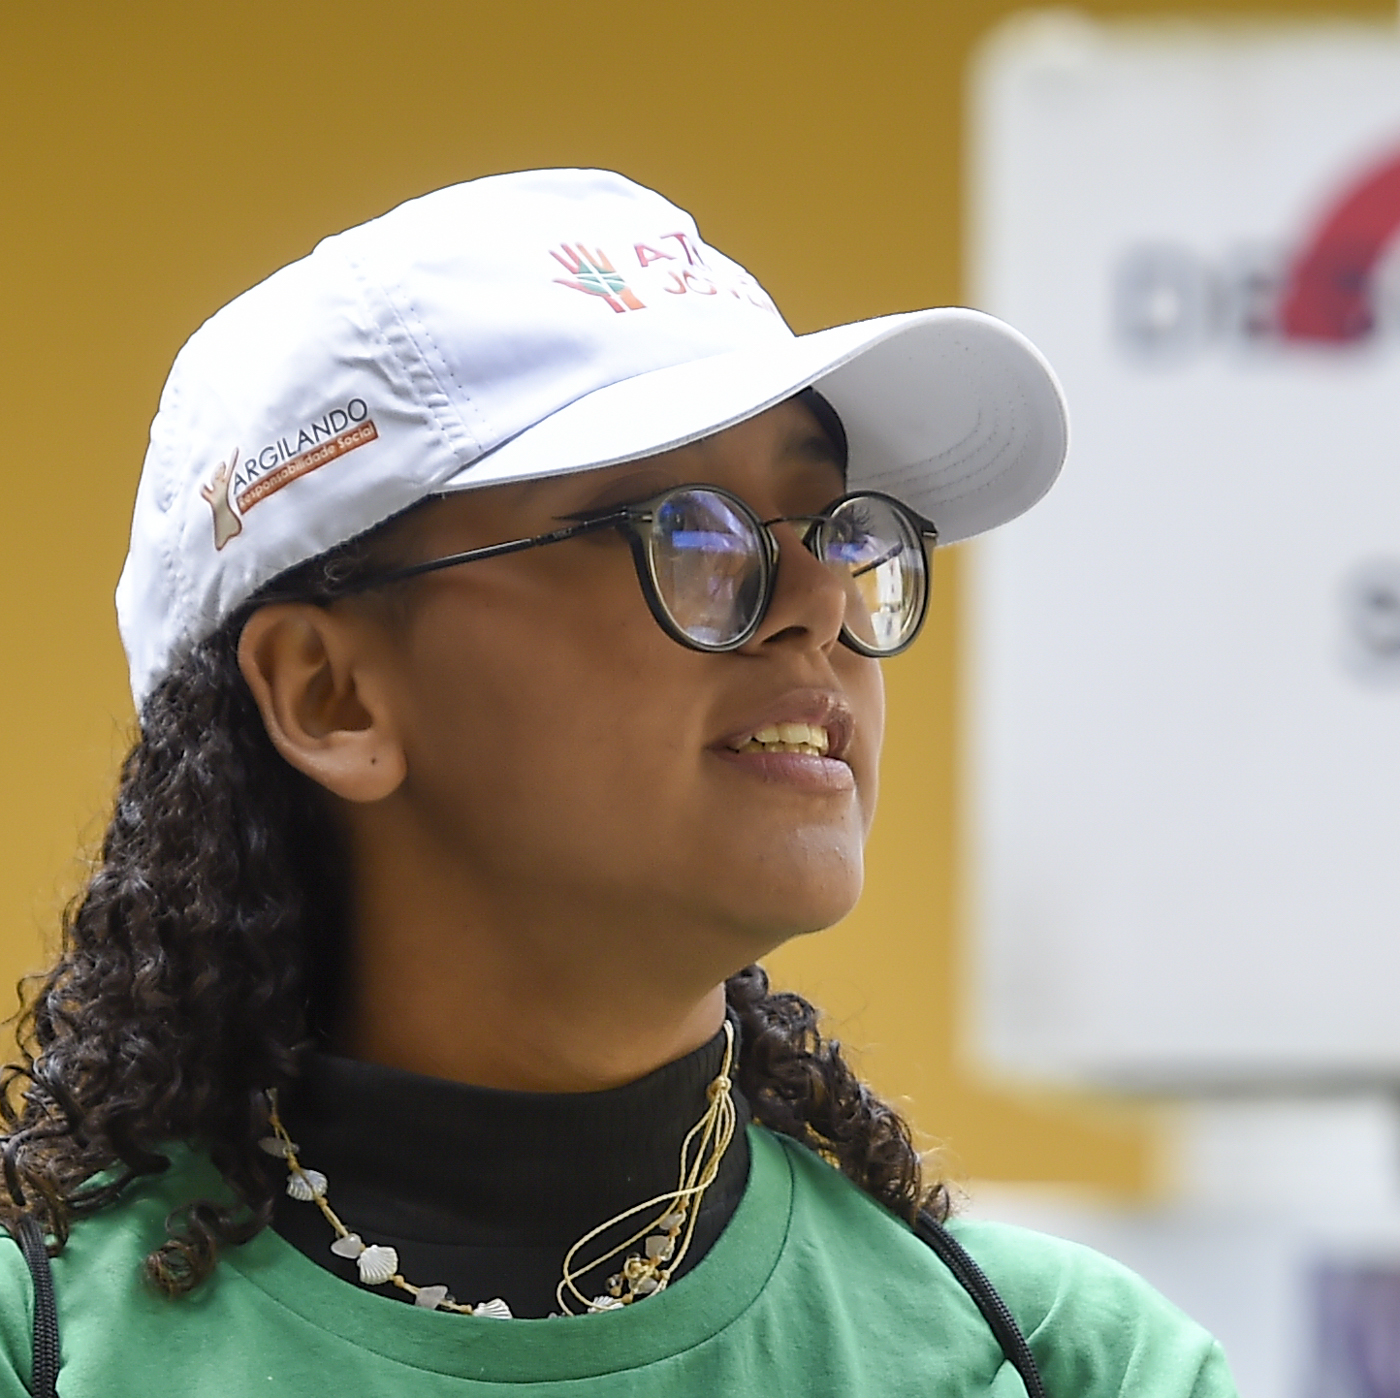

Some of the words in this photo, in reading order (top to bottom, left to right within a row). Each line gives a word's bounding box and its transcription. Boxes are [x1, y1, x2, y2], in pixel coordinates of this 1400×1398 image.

[233, 398, 368, 495] ARGILANDO
[238, 442, 337, 508] Responsabilidade
[337, 422, 376, 451] Social
